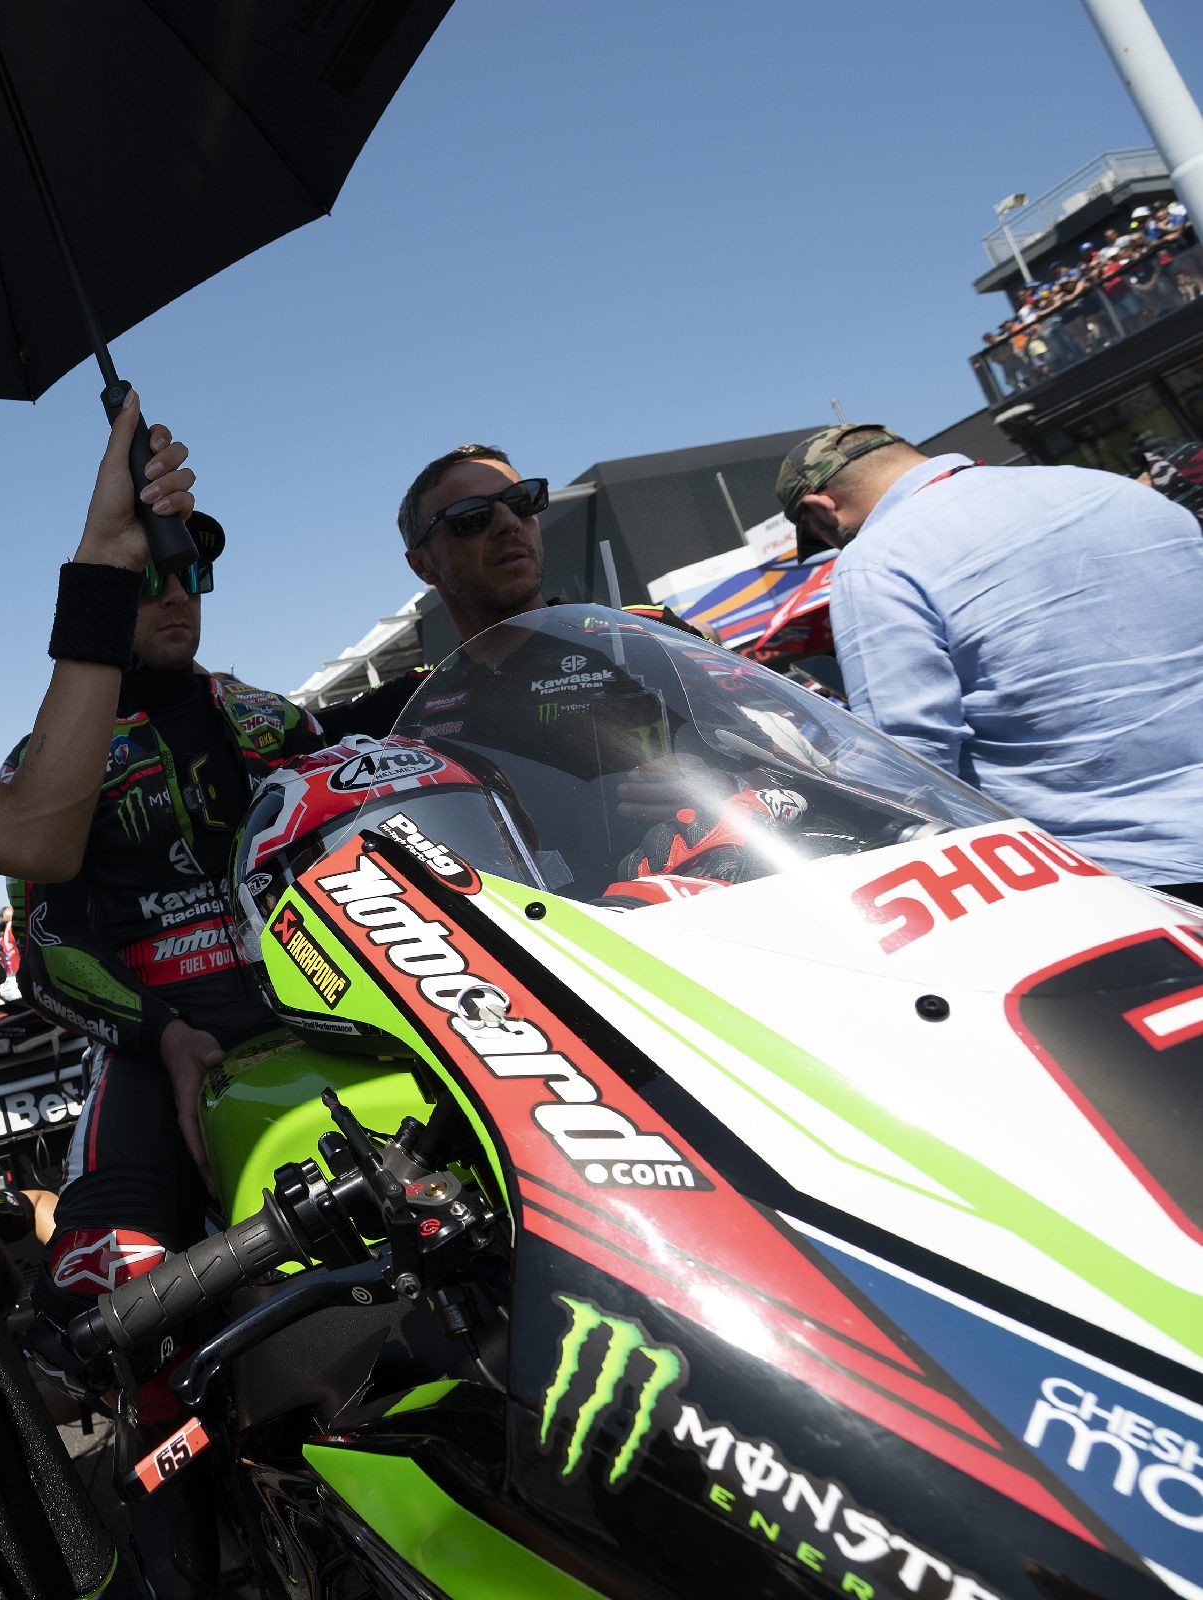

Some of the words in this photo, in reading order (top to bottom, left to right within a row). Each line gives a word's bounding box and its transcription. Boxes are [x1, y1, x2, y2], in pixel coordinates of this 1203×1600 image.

[531, 669, 614, 692] Kawasak
[343, 750, 430, 788] Arai
[386, 814, 464, 875] Puig
[161, 900, 222, 927] Racing
[180, 955, 207, 975] FUEL
[33, 981, 119, 1045] Kawasaki
[156, 1434, 192, 1479] 65
